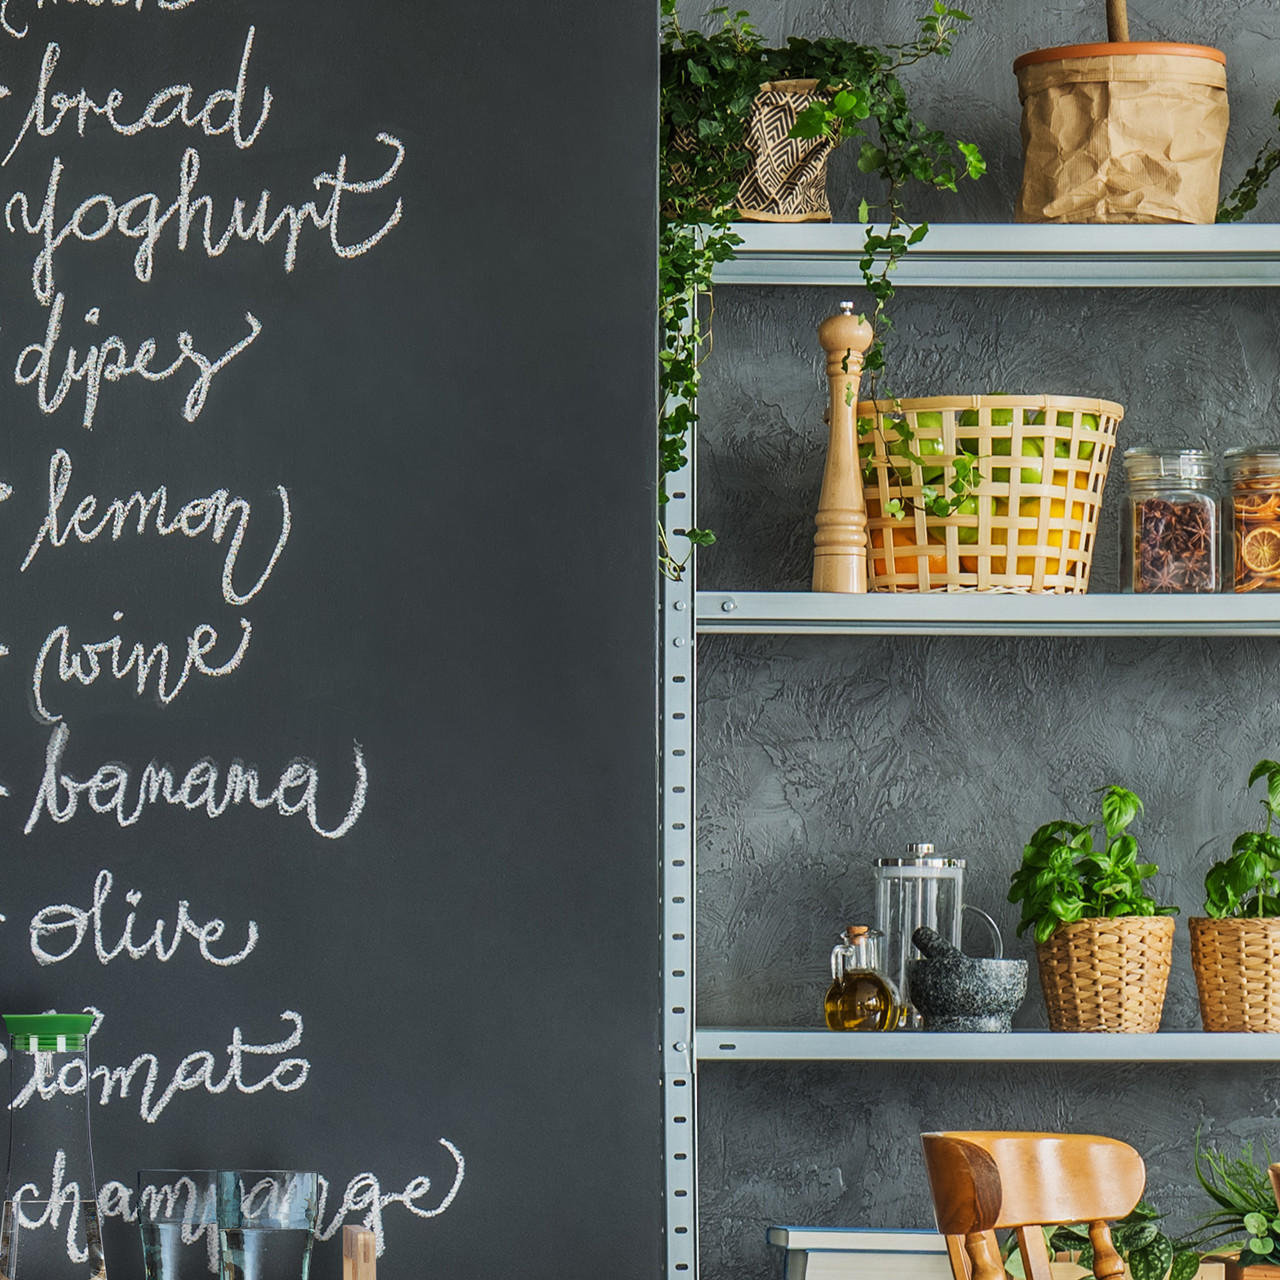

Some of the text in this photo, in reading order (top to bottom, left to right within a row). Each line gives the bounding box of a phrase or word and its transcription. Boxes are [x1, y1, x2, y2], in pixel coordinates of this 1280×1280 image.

[2, 25, 274, 165] bread
[5, 132, 406, 305] yoghurt
[20, 449, 292, 605] lemon
[32, 611, 253, 722] wine
[24, 722, 369, 839] banana
[29, 870, 260, 966] olive
[8, 1006, 312, 1124] tomato
